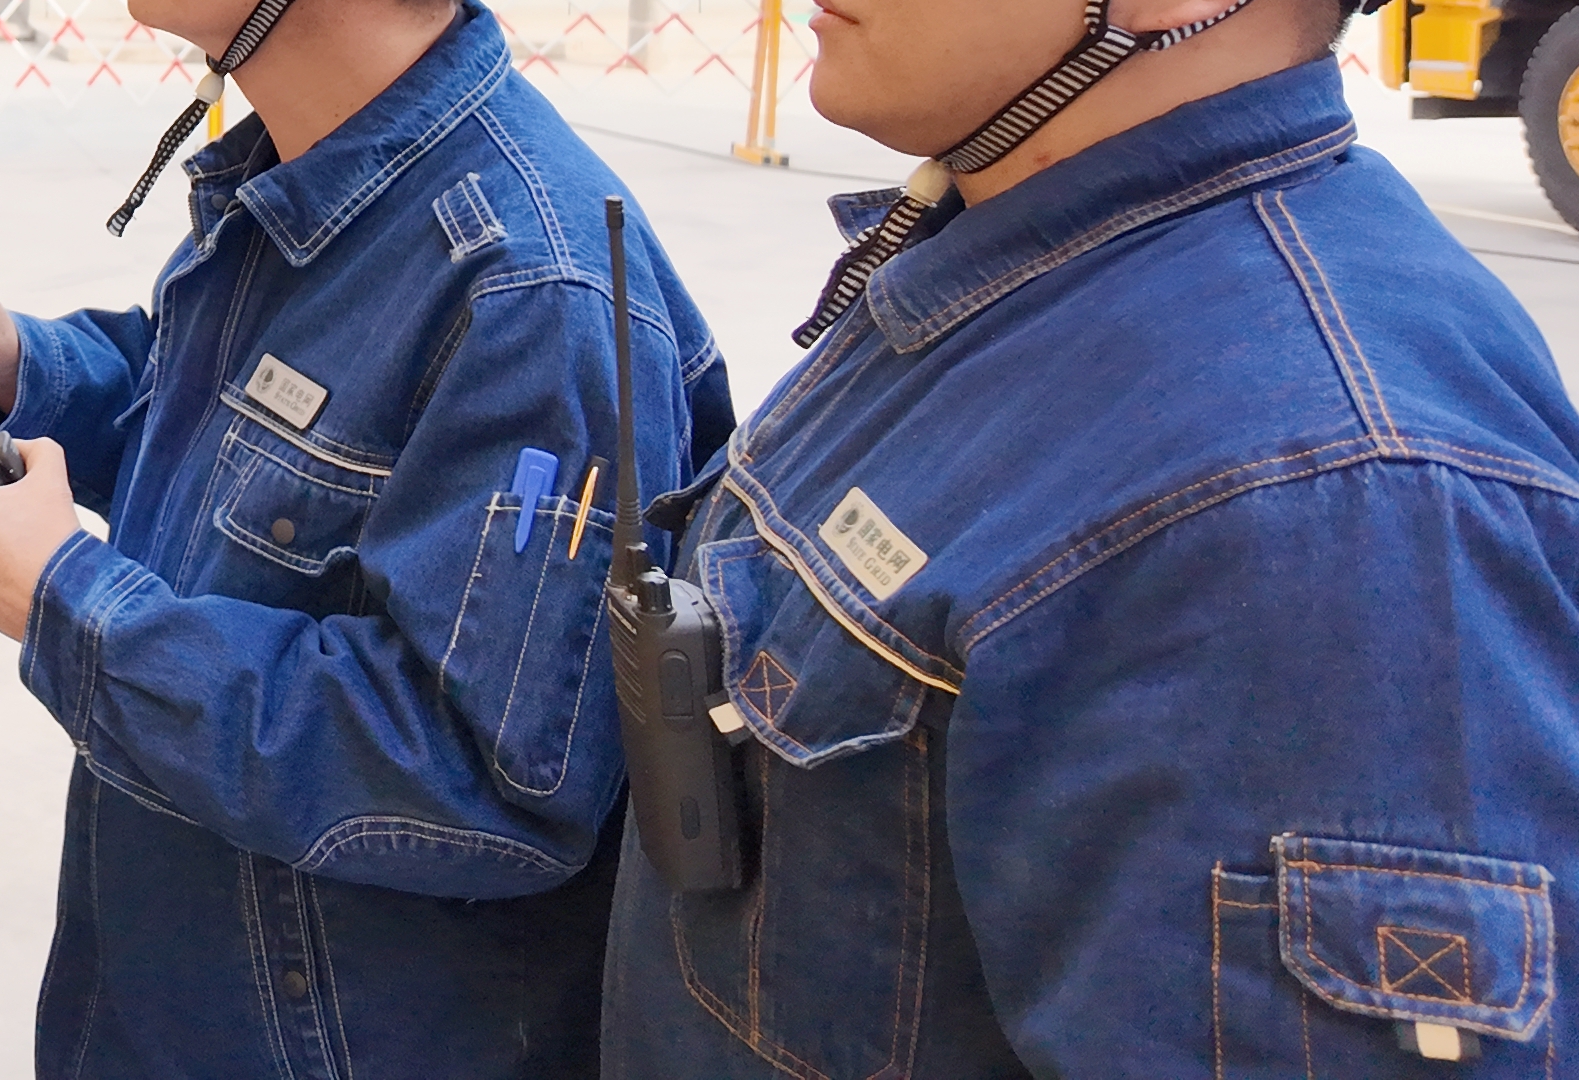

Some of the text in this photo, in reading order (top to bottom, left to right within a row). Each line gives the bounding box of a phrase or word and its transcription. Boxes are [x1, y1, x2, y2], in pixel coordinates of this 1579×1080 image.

[277, 377, 315, 408] 国家电网
[856, 517, 912, 575] 国家电网
